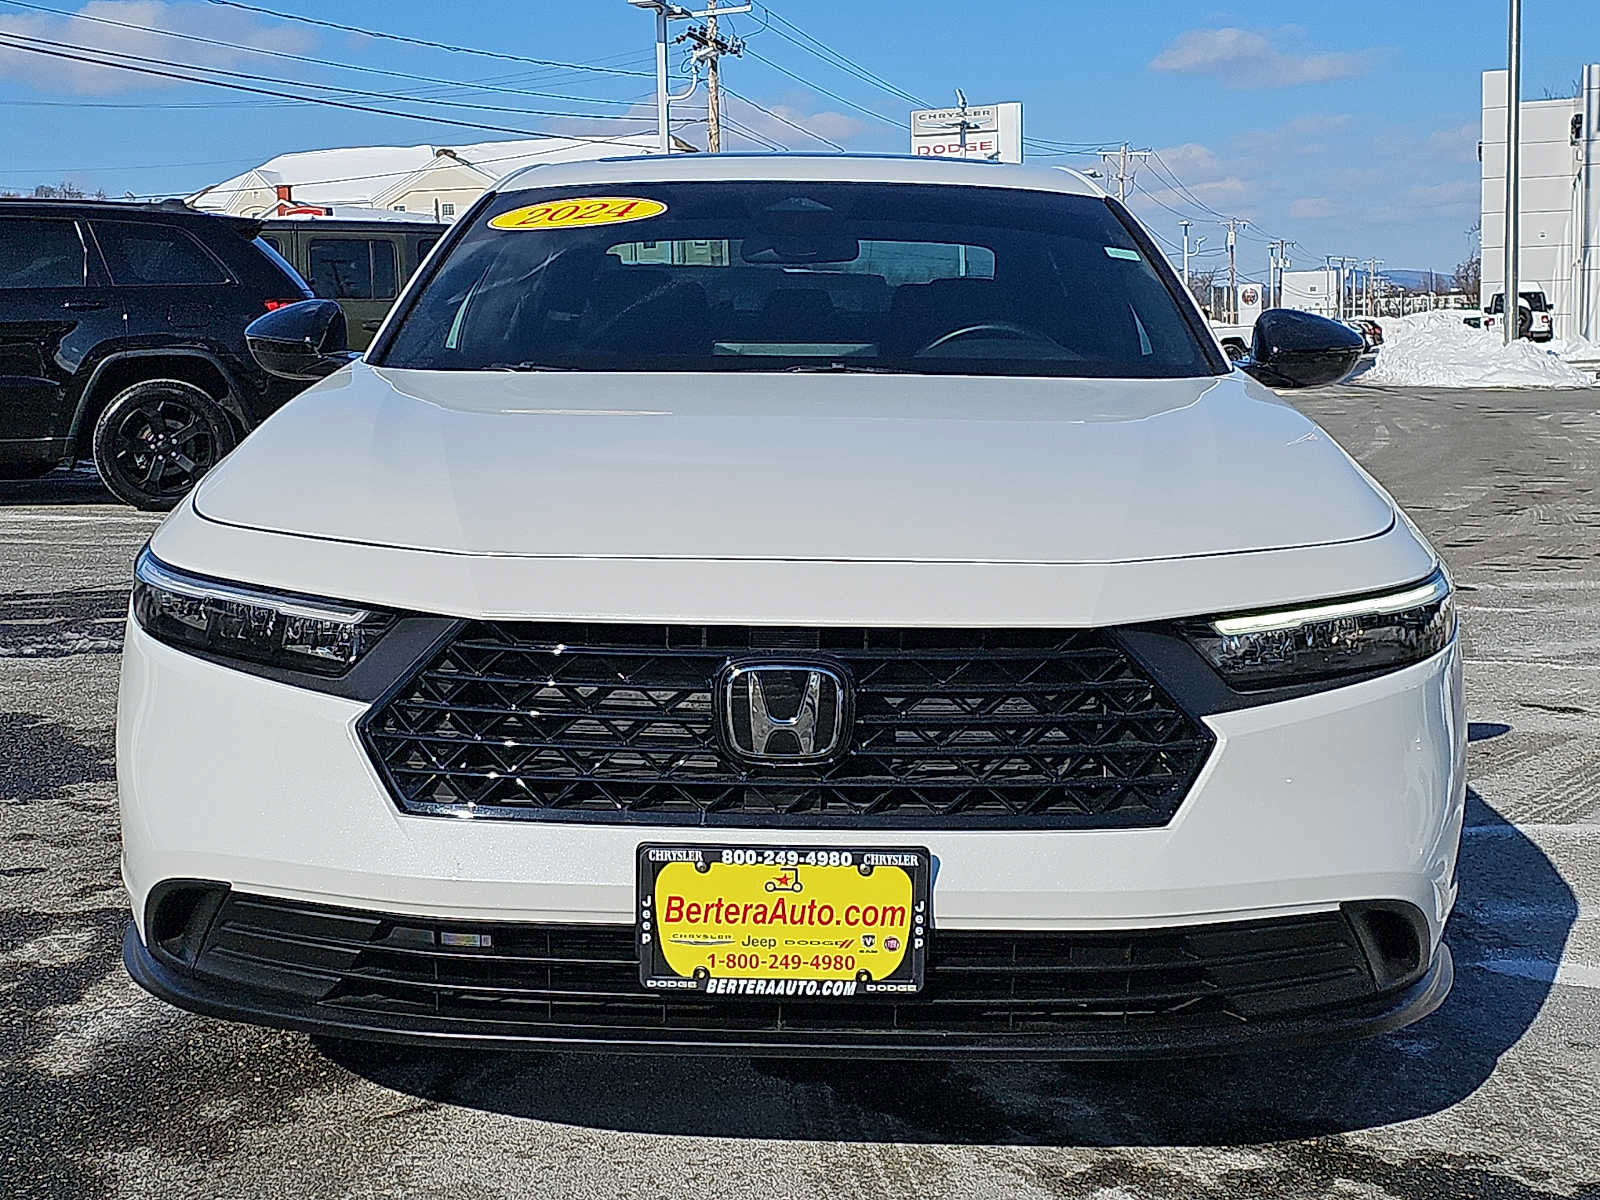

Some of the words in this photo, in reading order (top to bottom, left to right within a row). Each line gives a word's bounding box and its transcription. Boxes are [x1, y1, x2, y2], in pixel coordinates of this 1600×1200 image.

[918, 110, 991, 120] CHRYSLER
[917, 141, 993, 156] DODGE
[516, 201, 639, 226] 2024
[648, 849, 704, 862] CHRYSLER
[721, 849, 853, 867] 800-249-4980
[863, 853, 919, 867] CHRYSLER
[664, 896, 906, 927] BerteraAuto.com
[641, 895, 652, 945] Jeep
[914, 900, 925, 950] Jeep
[741, 935, 777, 949] Jeep
[707, 953, 856, 971] 1-800-249-4980
[646, 980, 698, 989] DODGE
[705, 978, 858, 997] BERTERAAUTO.COM
[866, 984, 917, 992] DODGE
